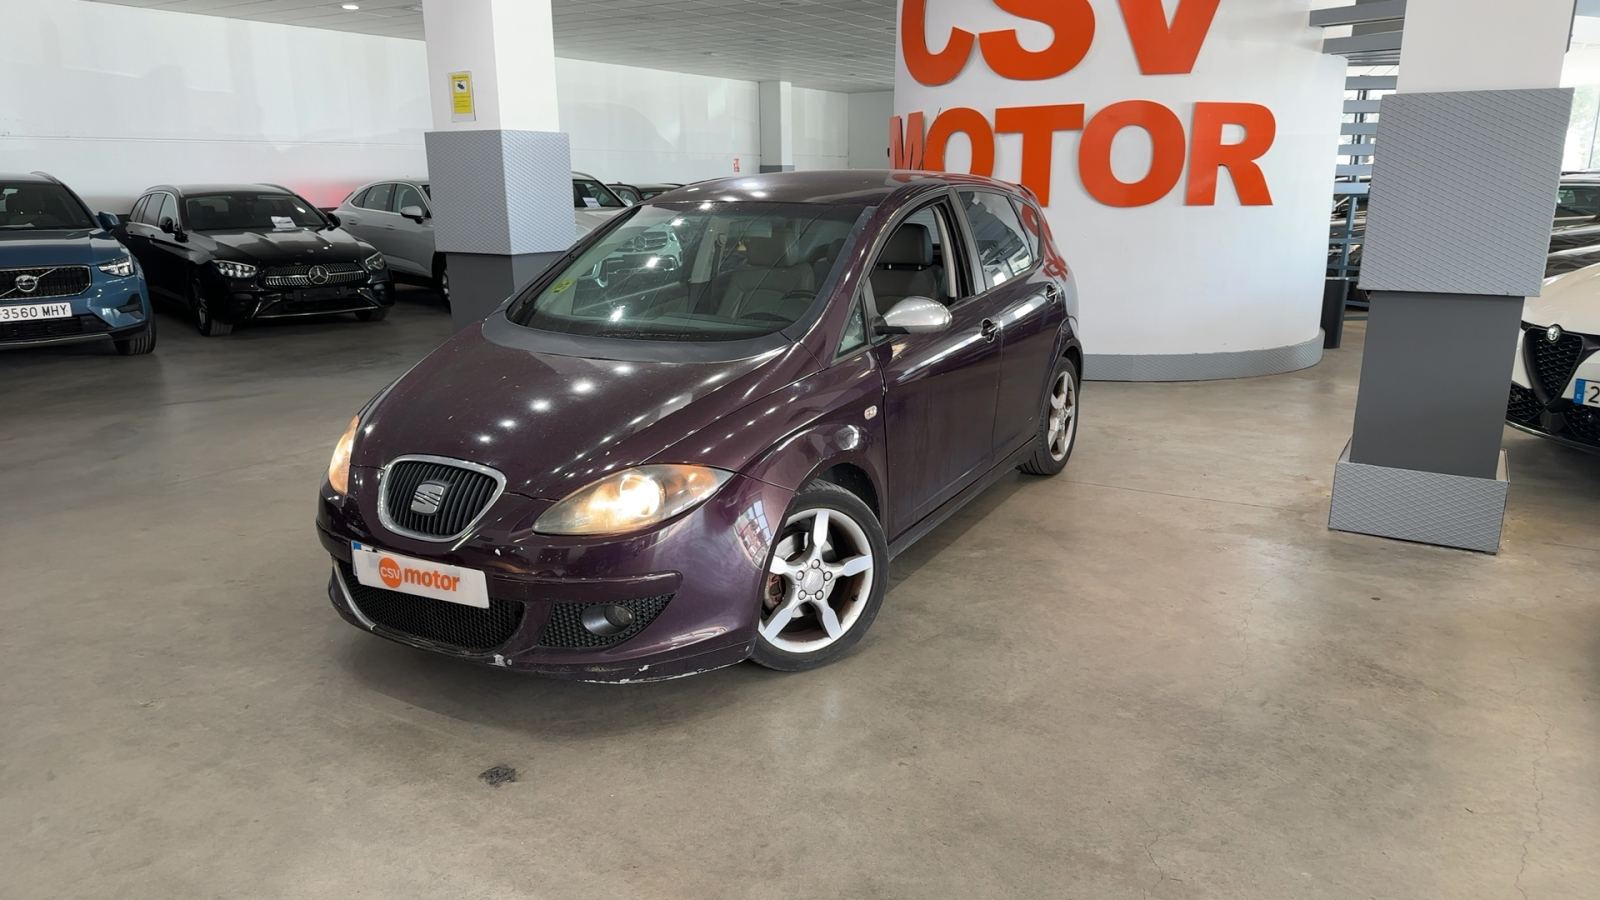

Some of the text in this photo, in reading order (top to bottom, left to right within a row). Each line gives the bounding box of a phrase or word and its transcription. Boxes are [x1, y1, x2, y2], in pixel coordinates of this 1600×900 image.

[889, 100, 1277, 208] MOTOR
[2, 304, 67, 320] 3560 MHY
[404, 567, 460, 592] motor
